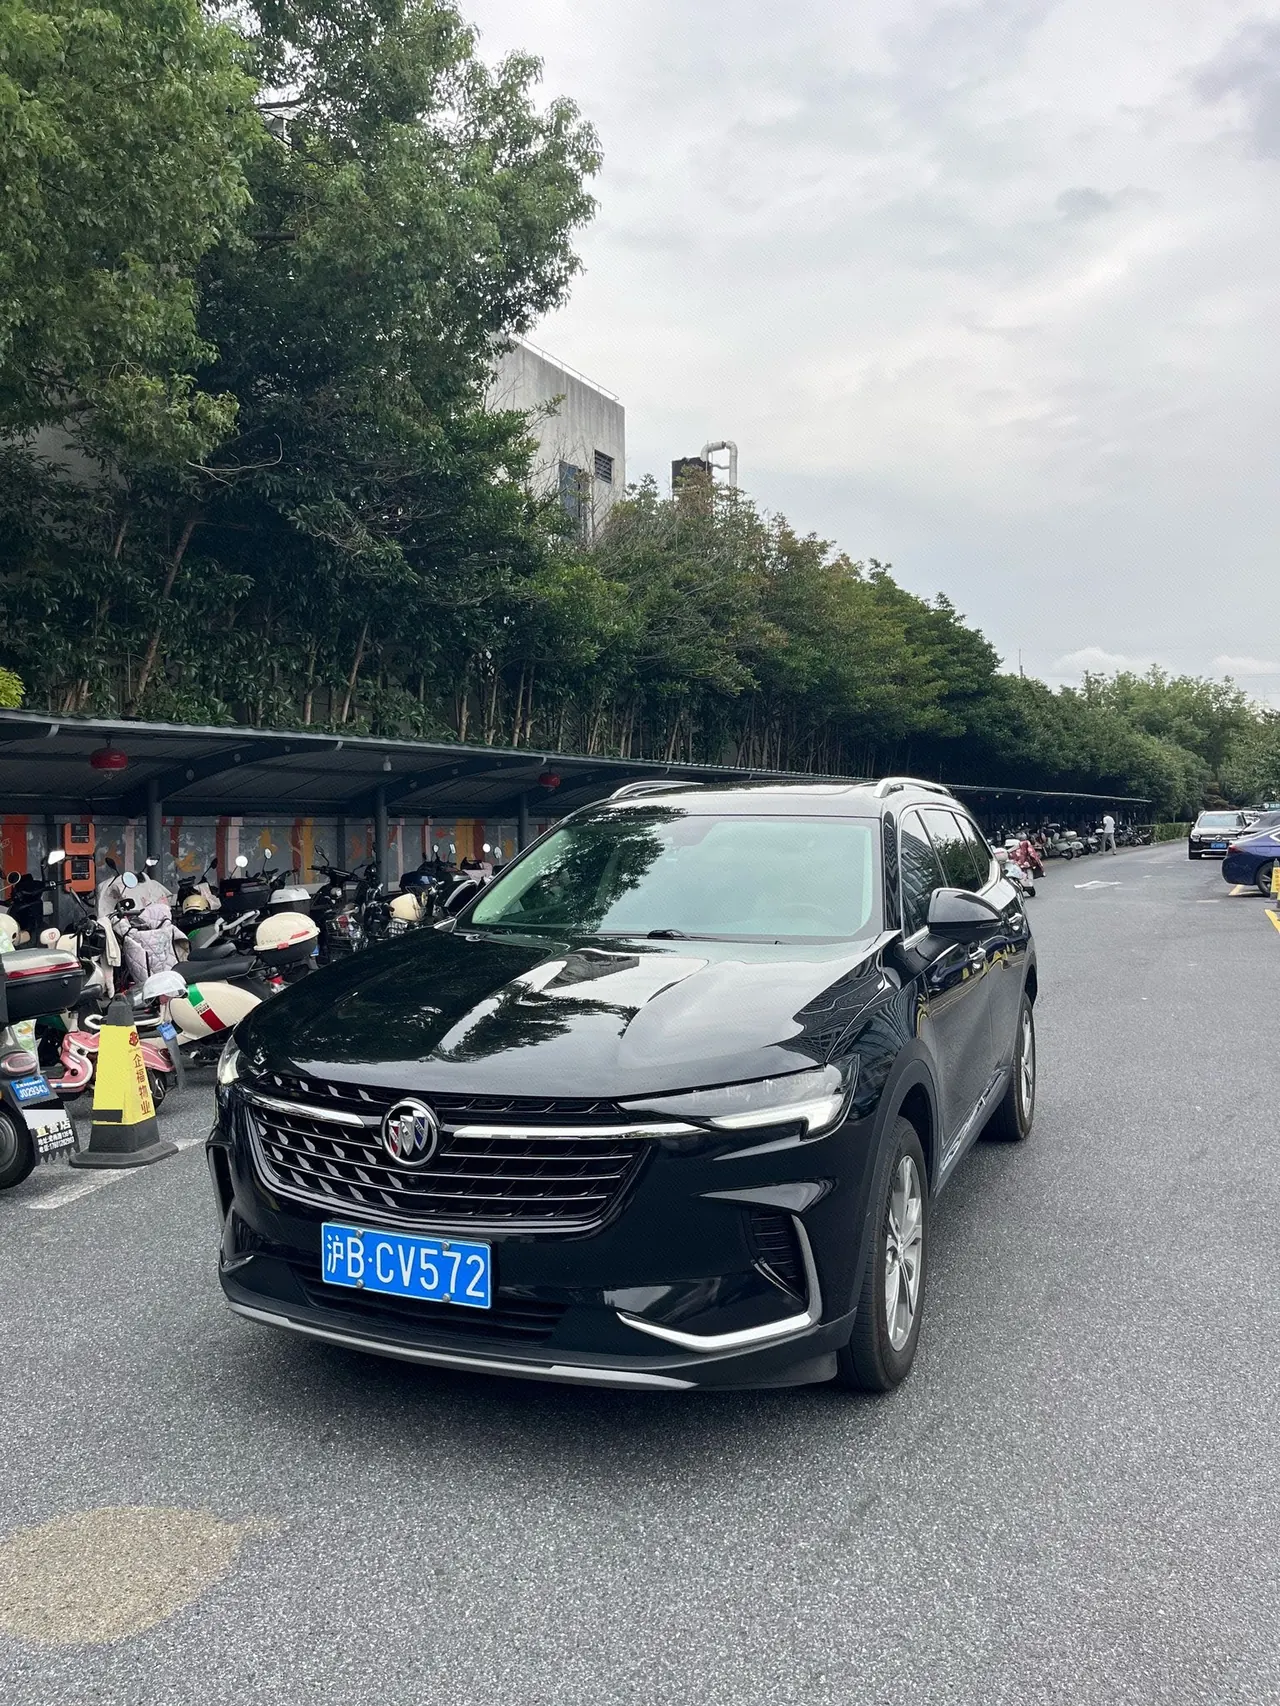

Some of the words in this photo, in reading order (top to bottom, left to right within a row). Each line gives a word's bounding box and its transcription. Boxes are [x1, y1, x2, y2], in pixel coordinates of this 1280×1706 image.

[133, 1053, 151, 1115] 企福物业
[327, 1234, 485, 1298] 沪B·CV572
